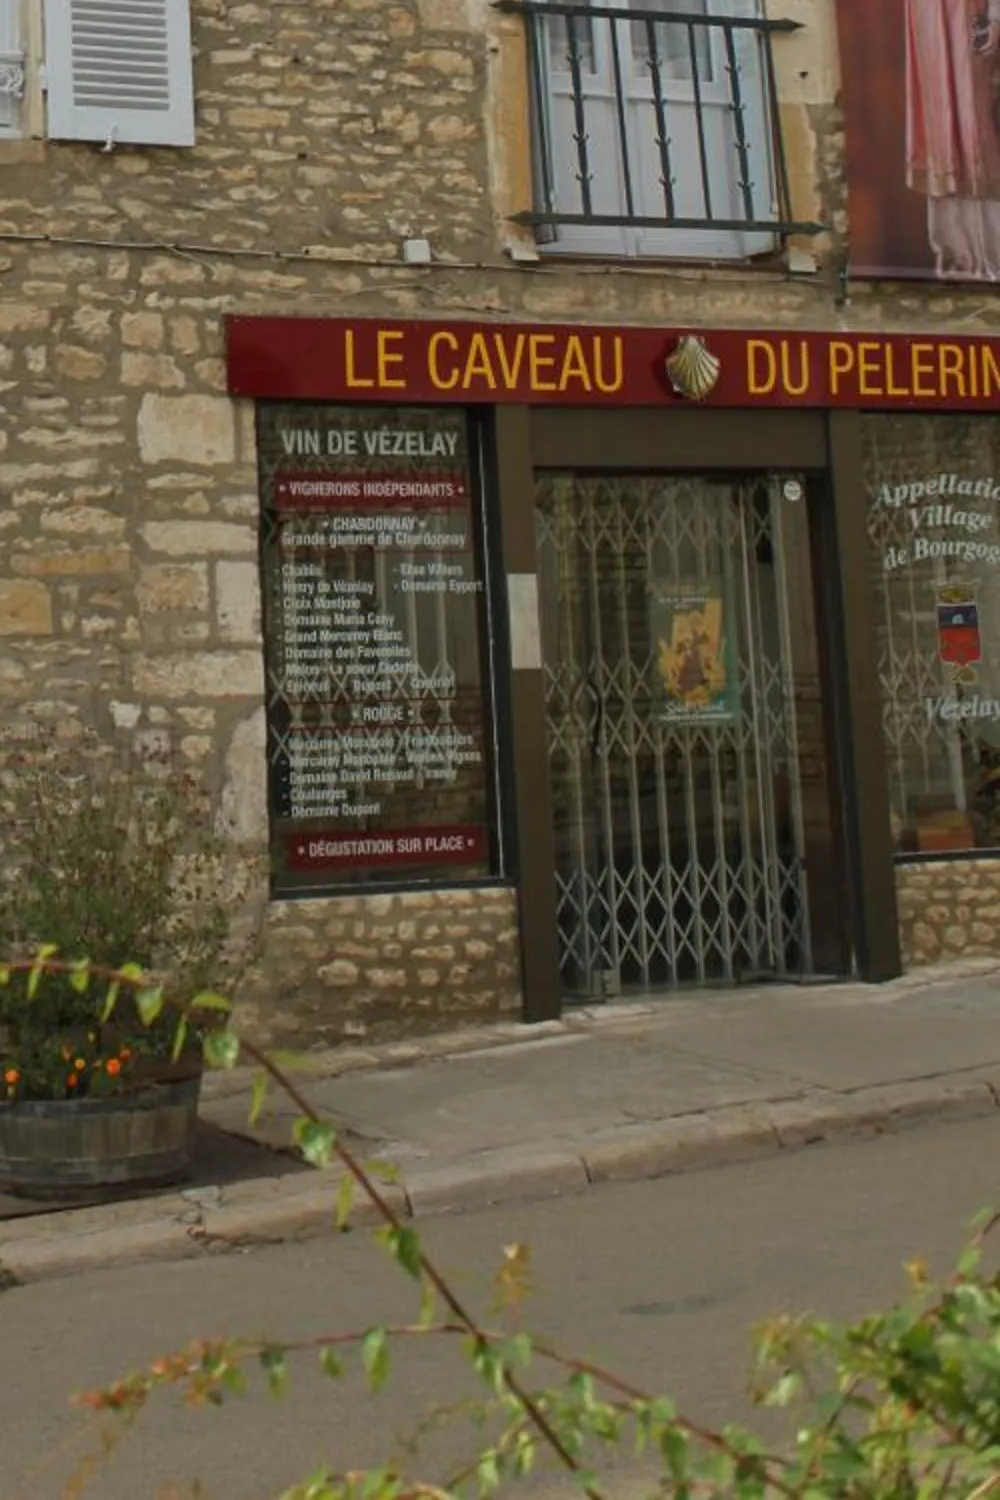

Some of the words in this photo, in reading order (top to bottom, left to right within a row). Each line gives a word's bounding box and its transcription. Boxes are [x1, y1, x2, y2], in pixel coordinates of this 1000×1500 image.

[345, 329, 407, 388] LE
[427, 330, 623, 393] CAVEAU
[747, 339, 810, 396] DU
[828, 340, 1000, 398] PELERIN
[280, 429, 321, 455] VIN
[327, 430, 358, 455] DE
[363, 425, 458, 456] VÉZELAY
[289, 480, 361, 497] VIGNERONS
[363, 479, 455, 498] INDÉPENDANTS
[332, 516, 417, 532] CHARDONNAY
[908, 503, 993, 533] Village
[281, 532, 325, 546] Grande
[329, 534, 375, 549] gamme
[378, 532, 392, 546] de
[395, 532, 467, 548] Chardonnay
[883, 546, 908, 571] de
[363, 706, 405, 722] ROUGE
[308, 839, 394, 858] DÉGUSTATION
[395, 837, 422, 854] SUR
[425, 835, 464, 852] PLACE
